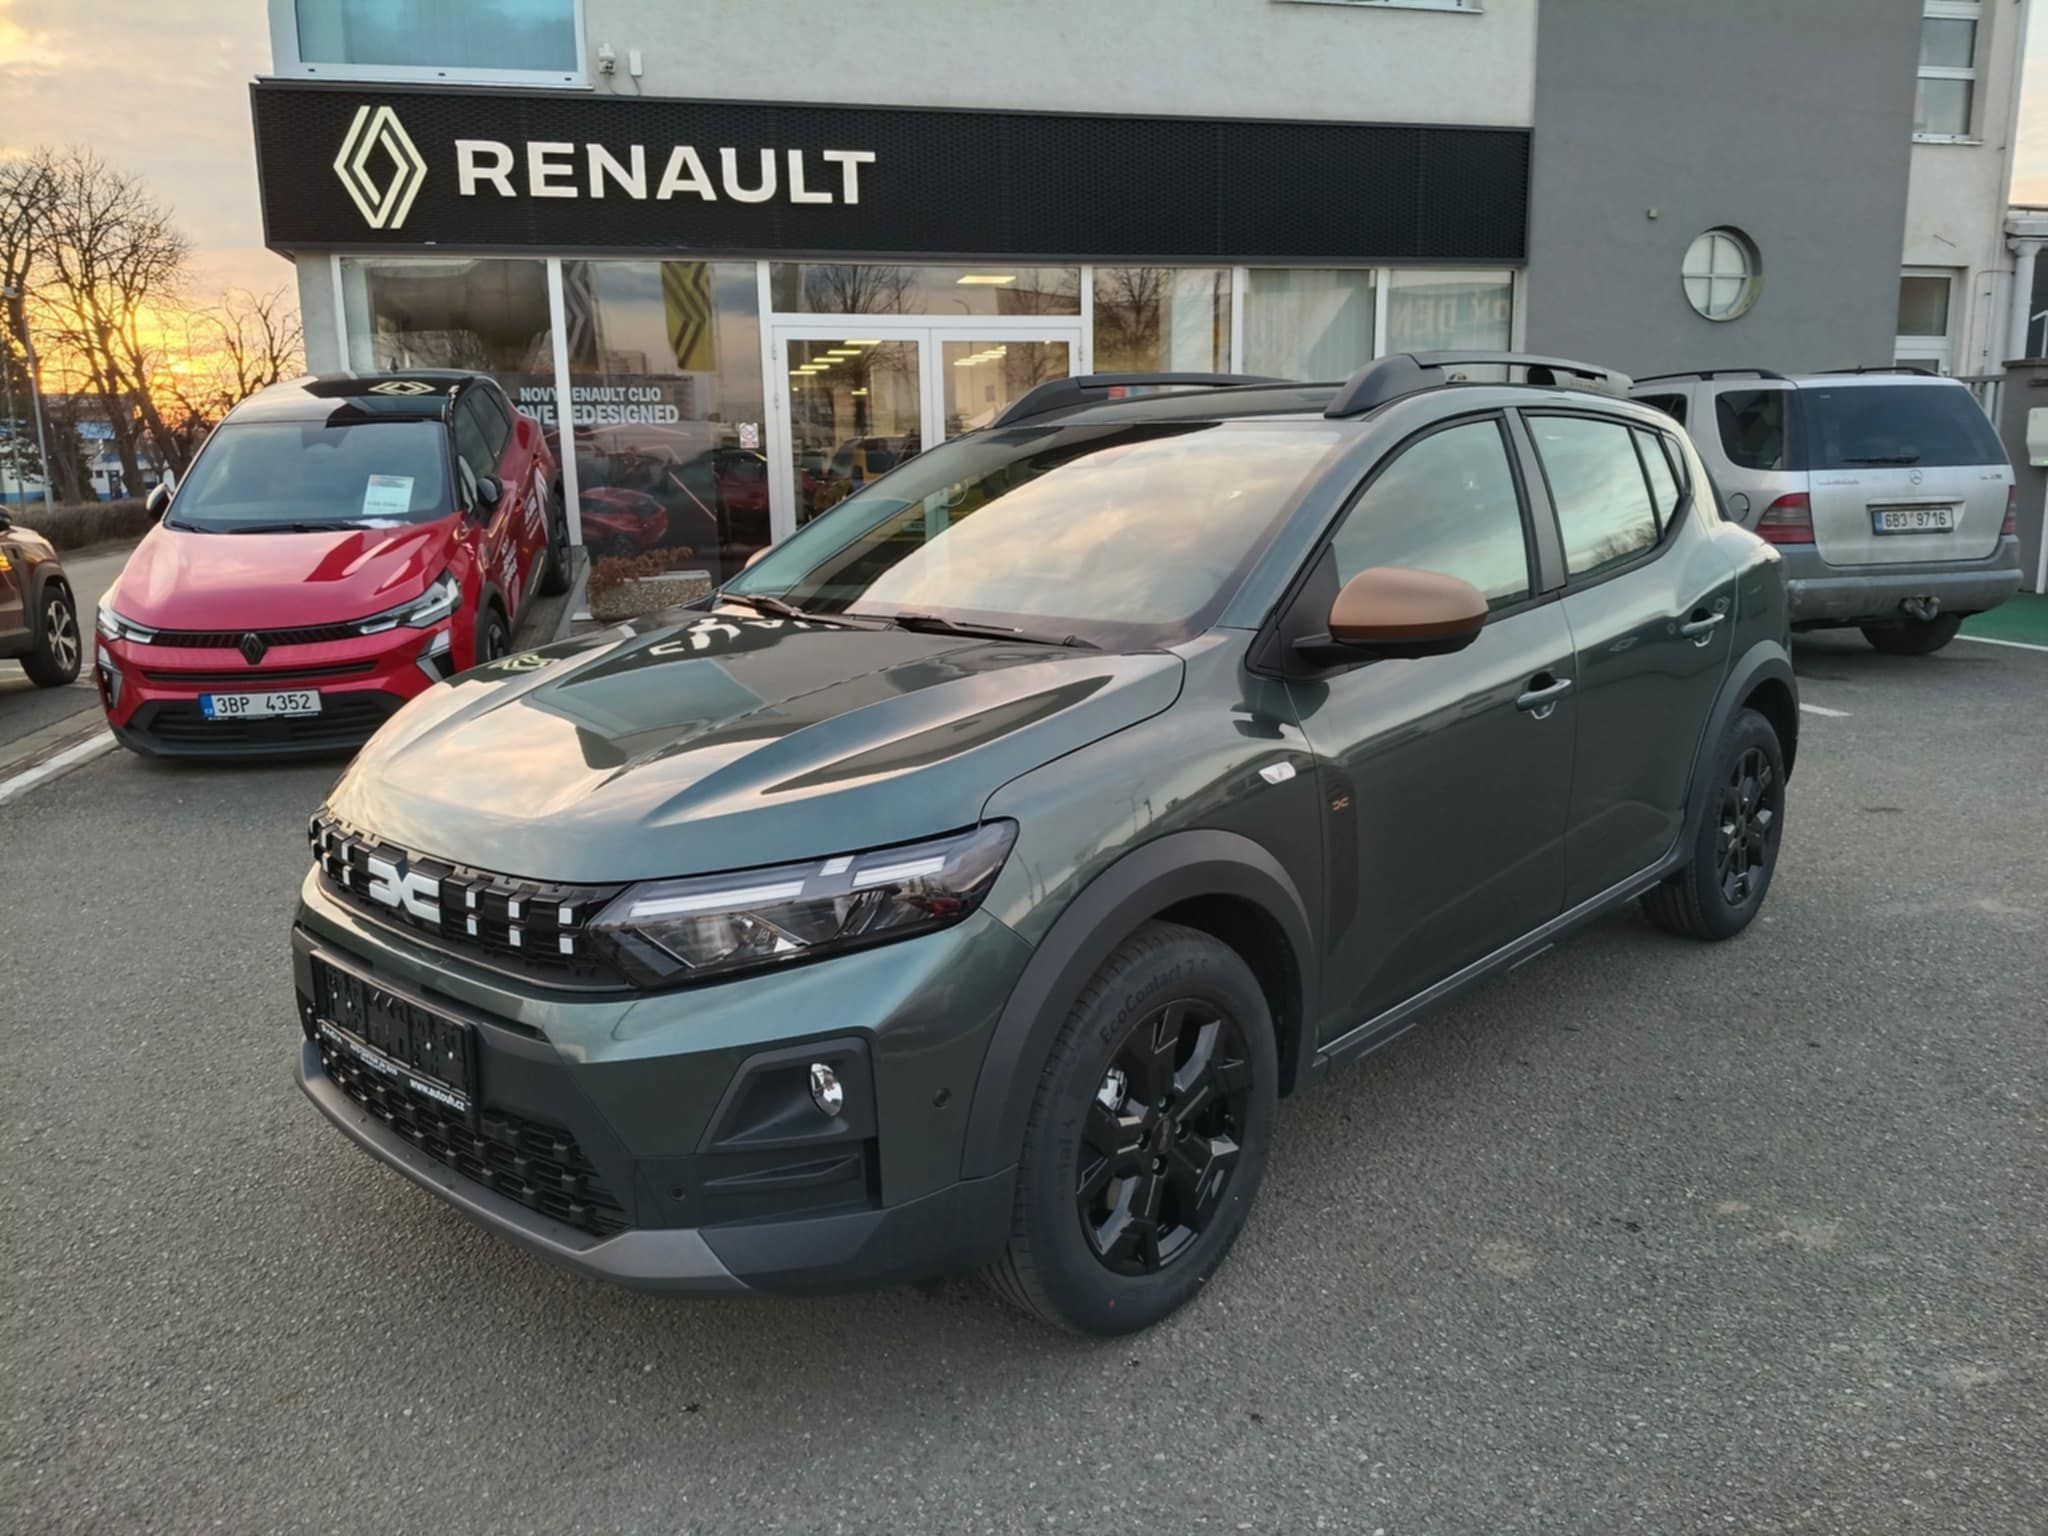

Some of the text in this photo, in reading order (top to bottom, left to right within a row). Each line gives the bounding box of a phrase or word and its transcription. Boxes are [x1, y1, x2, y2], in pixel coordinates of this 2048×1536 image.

[455, 139, 875, 205] RENAULT
[572, 387, 626, 402] ENAULT
[628, 387, 661, 402] CLIO
[516, 405, 679, 425] OVE EDESIGNED
[1917, 510, 1946, 527] 9716
[216, 697, 250, 713] 3BP
[265, 694, 312, 711] 4352
